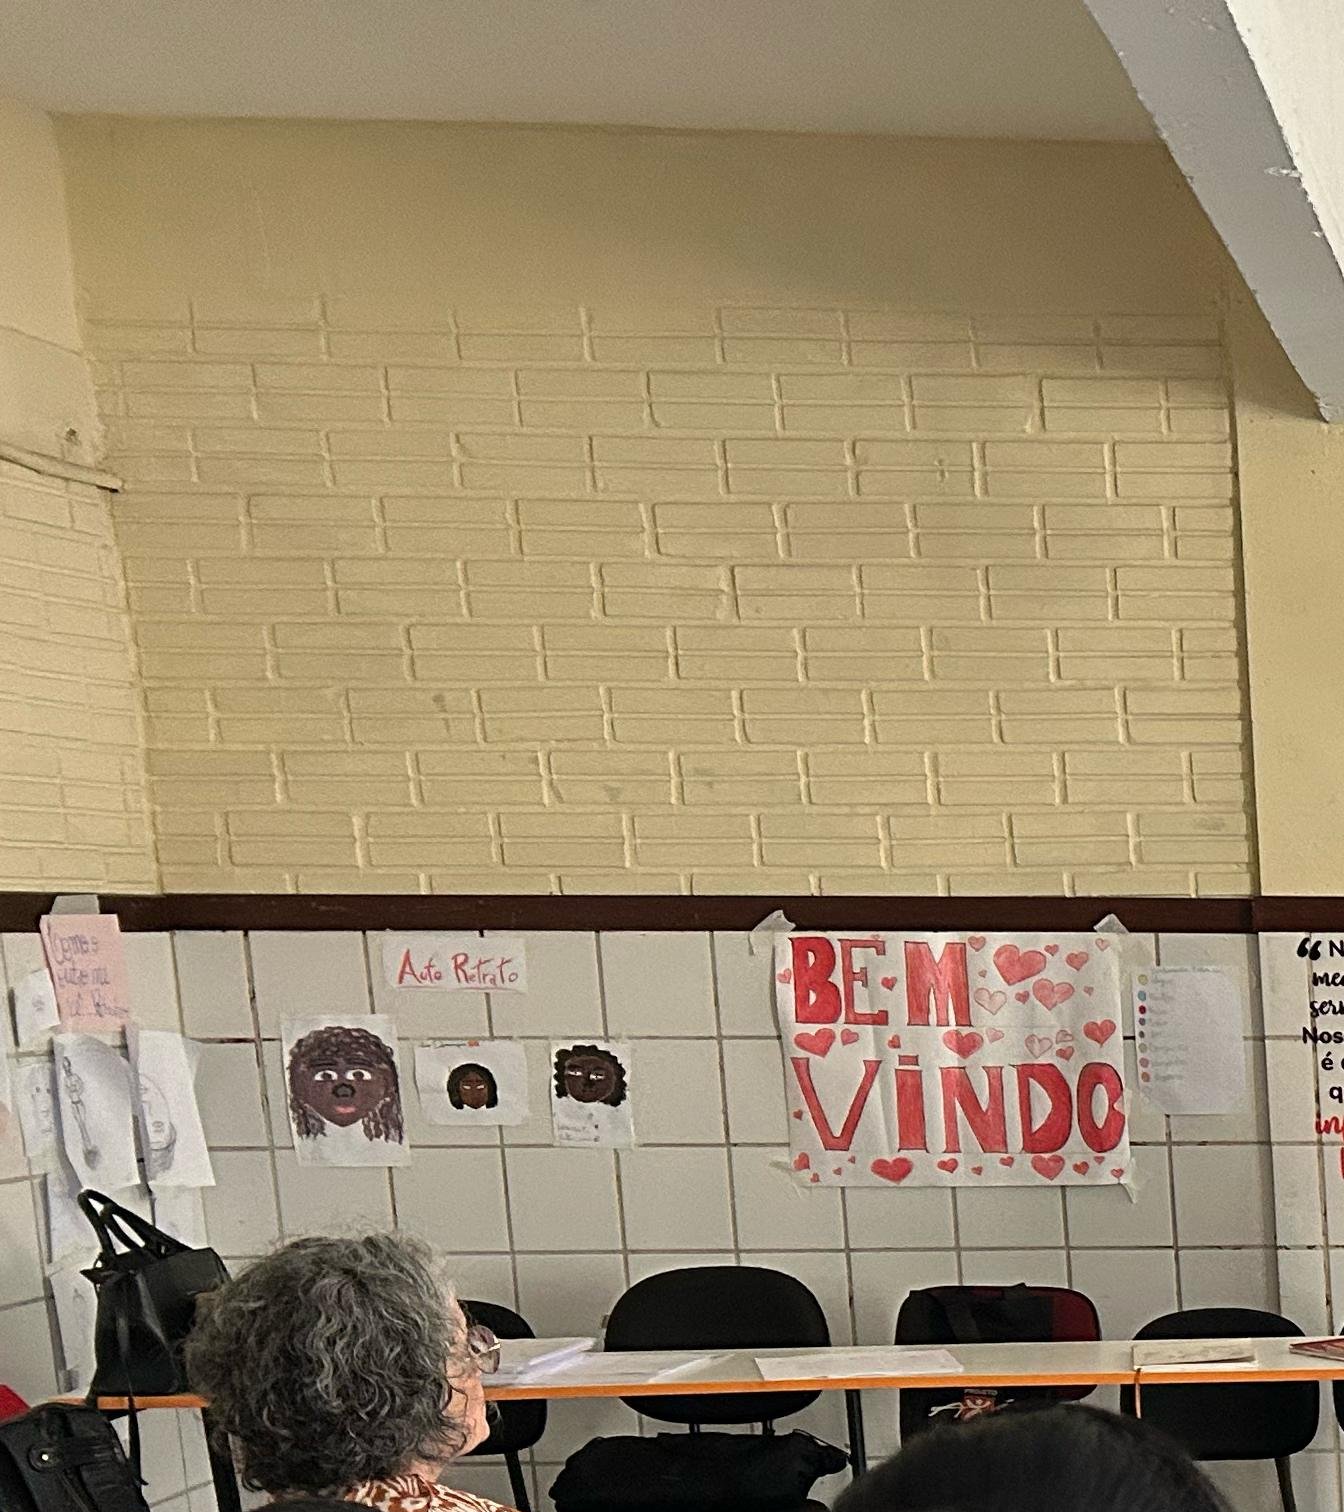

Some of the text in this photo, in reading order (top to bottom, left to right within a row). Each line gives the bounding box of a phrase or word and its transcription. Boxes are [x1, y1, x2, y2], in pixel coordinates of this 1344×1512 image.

[397, 949, 519, 986] Auto Retrato
[789, 937, 973, 1027] BEM
[1321, 1052, 1334, 1070] é
